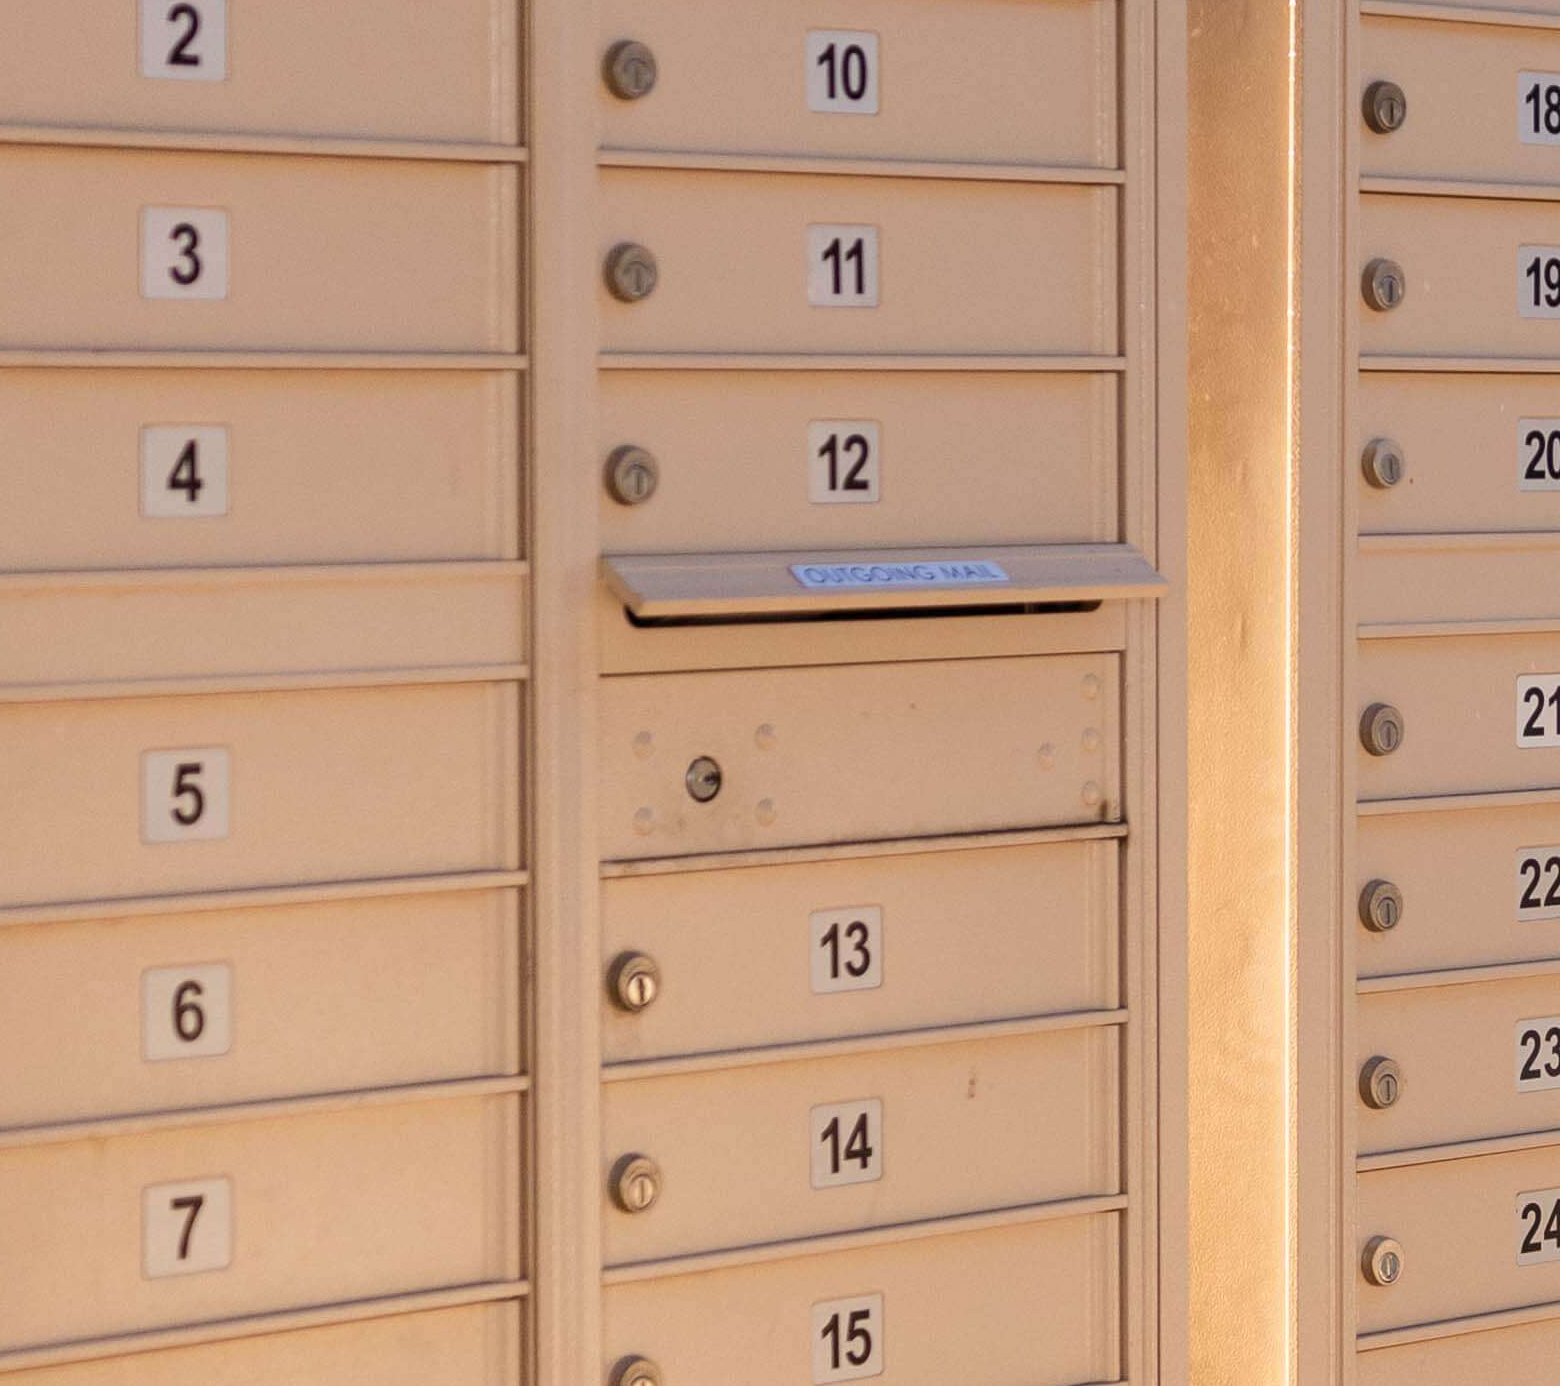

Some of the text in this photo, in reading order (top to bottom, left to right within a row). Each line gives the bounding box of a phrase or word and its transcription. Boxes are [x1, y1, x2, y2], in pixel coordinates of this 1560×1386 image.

[168, 3, 200, 67] 2
[817, 43, 867, 101] 10
[171, 223, 201, 286] 3
[823, 238, 864, 295] 11
[168, 440, 203, 502] 4
[819, 434, 869, 491] 12
[802, 562, 998, 584] OUTGOING MAIL
[173, 763, 204, 826] 5
[821, 921, 871, 979] 13
[173, 980, 205, 1042] 6
[821, 1112, 873, 1174] 14
[171, 1195, 204, 1260] 7
[821, 1308, 872, 1369] 15
